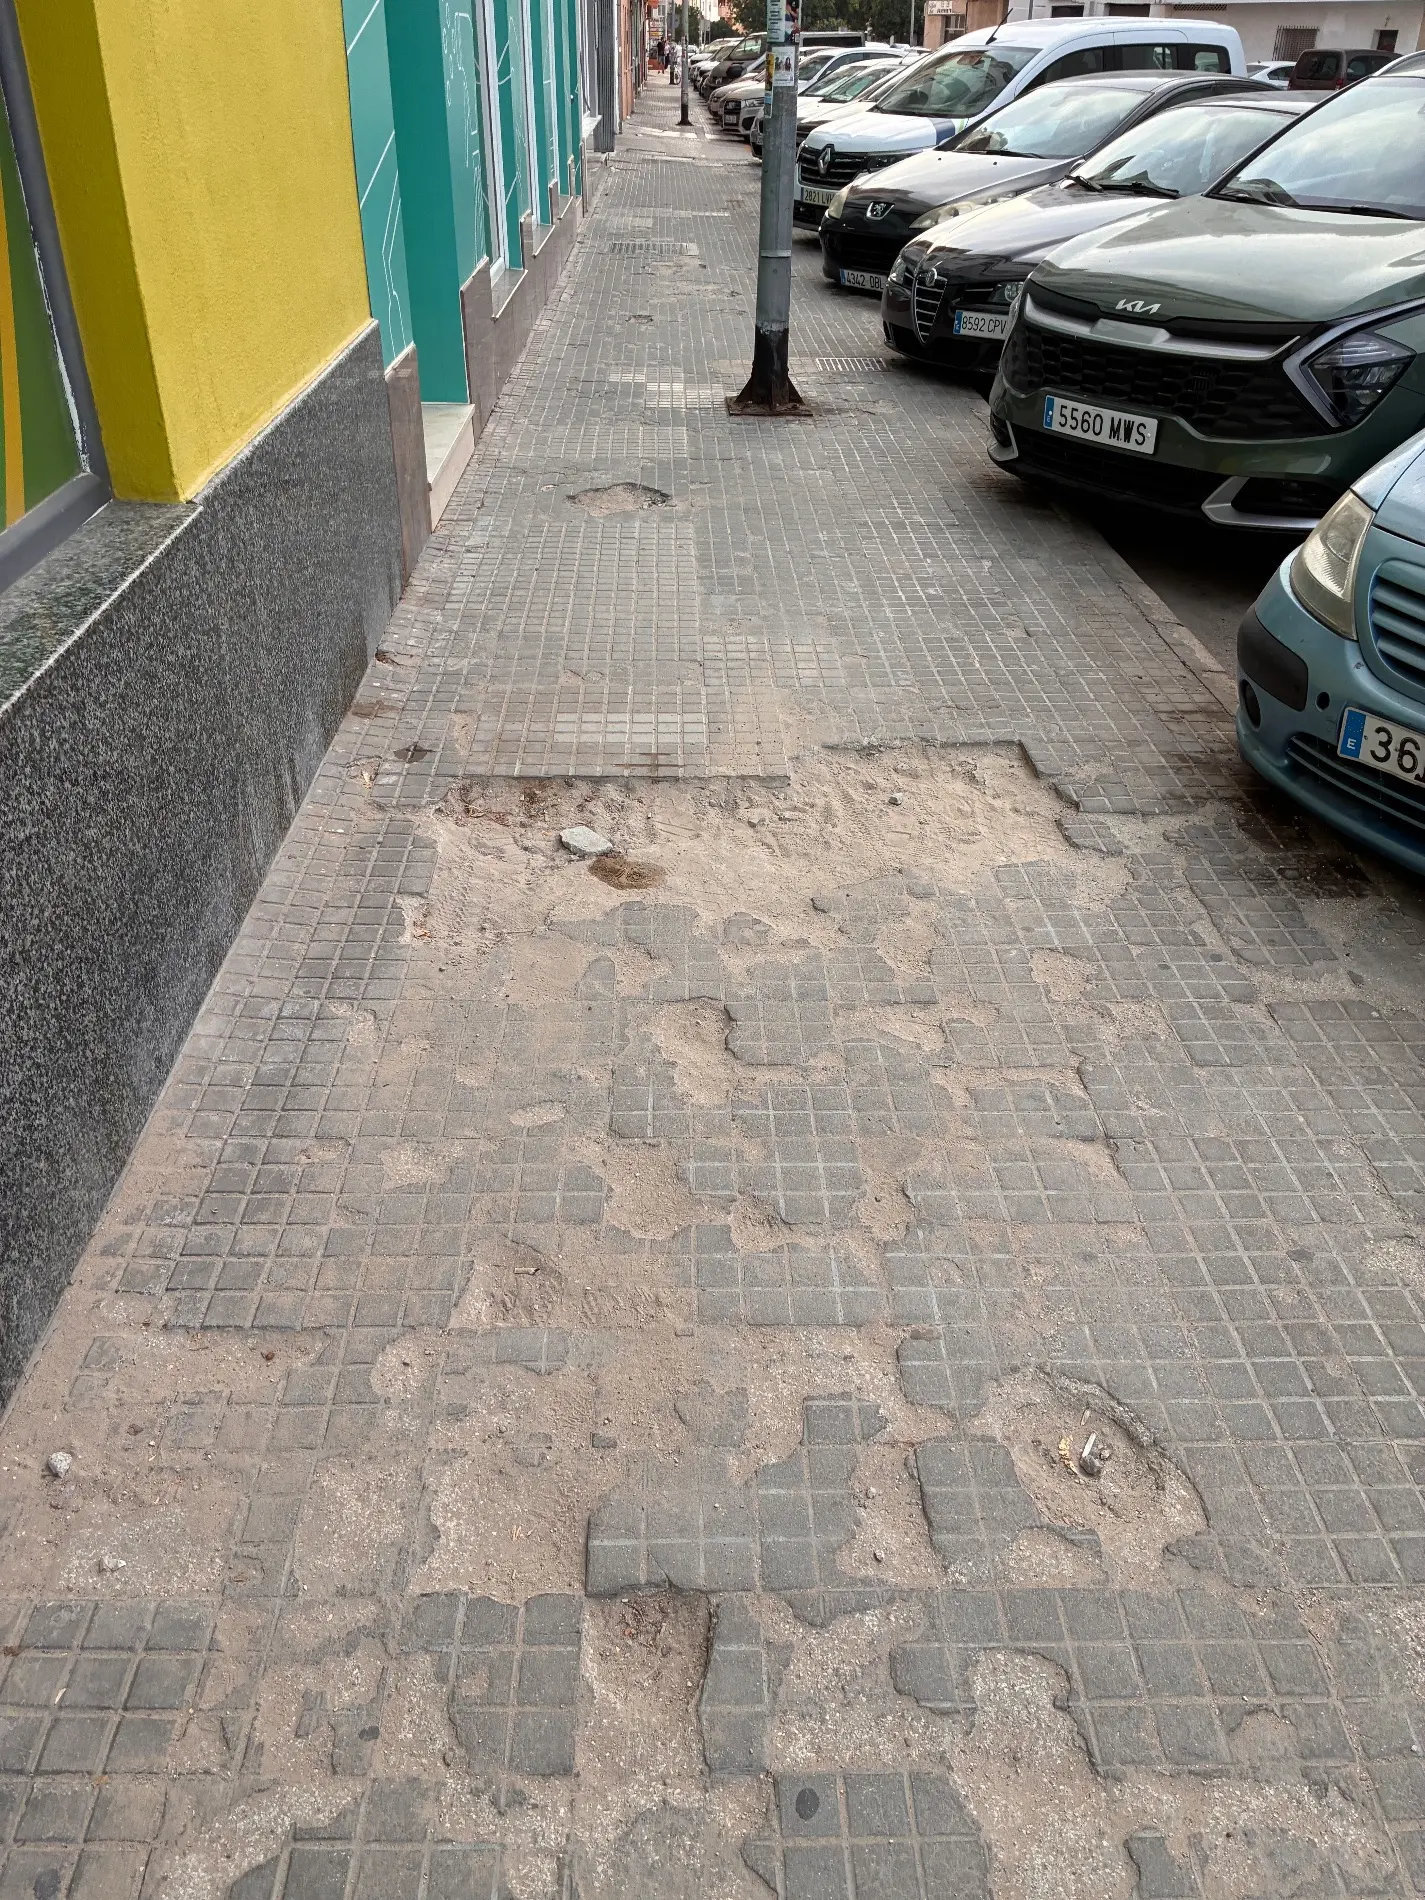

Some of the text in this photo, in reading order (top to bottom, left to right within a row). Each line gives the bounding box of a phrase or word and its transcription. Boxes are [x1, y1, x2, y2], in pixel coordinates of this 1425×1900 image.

[805, 190, 820, 203] 2821
[847, 272, 865, 286] 4342
[869, 275, 884, 290] DBL
[1115, 298, 1161, 315] KIA
[962, 316, 1007, 335] 8592 CPV
[1059, 405, 1104, 436] 5560
[1109, 416, 1147, 446] MWS
[1346, 726, 1425, 780] E 36
